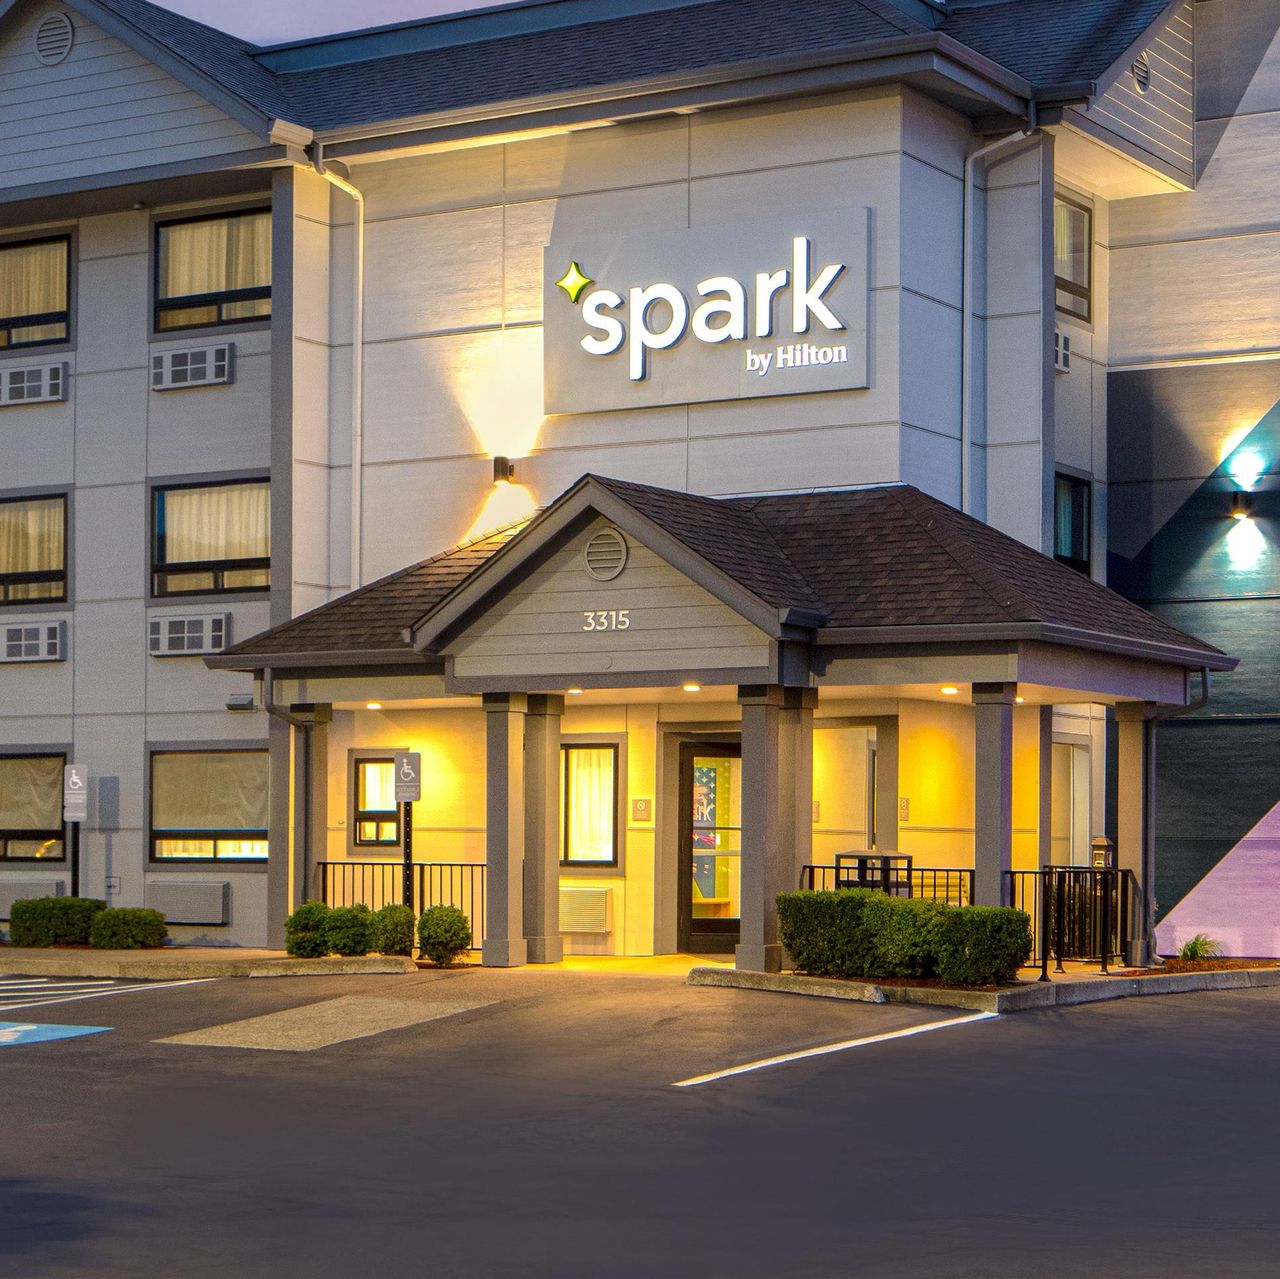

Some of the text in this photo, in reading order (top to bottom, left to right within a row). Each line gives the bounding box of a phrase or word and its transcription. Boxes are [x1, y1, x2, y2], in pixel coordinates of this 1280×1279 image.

[580, 236, 846, 381] spark
[745, 343, 848, 376] by Hilton
[582, 610, 630, 631] 3315
